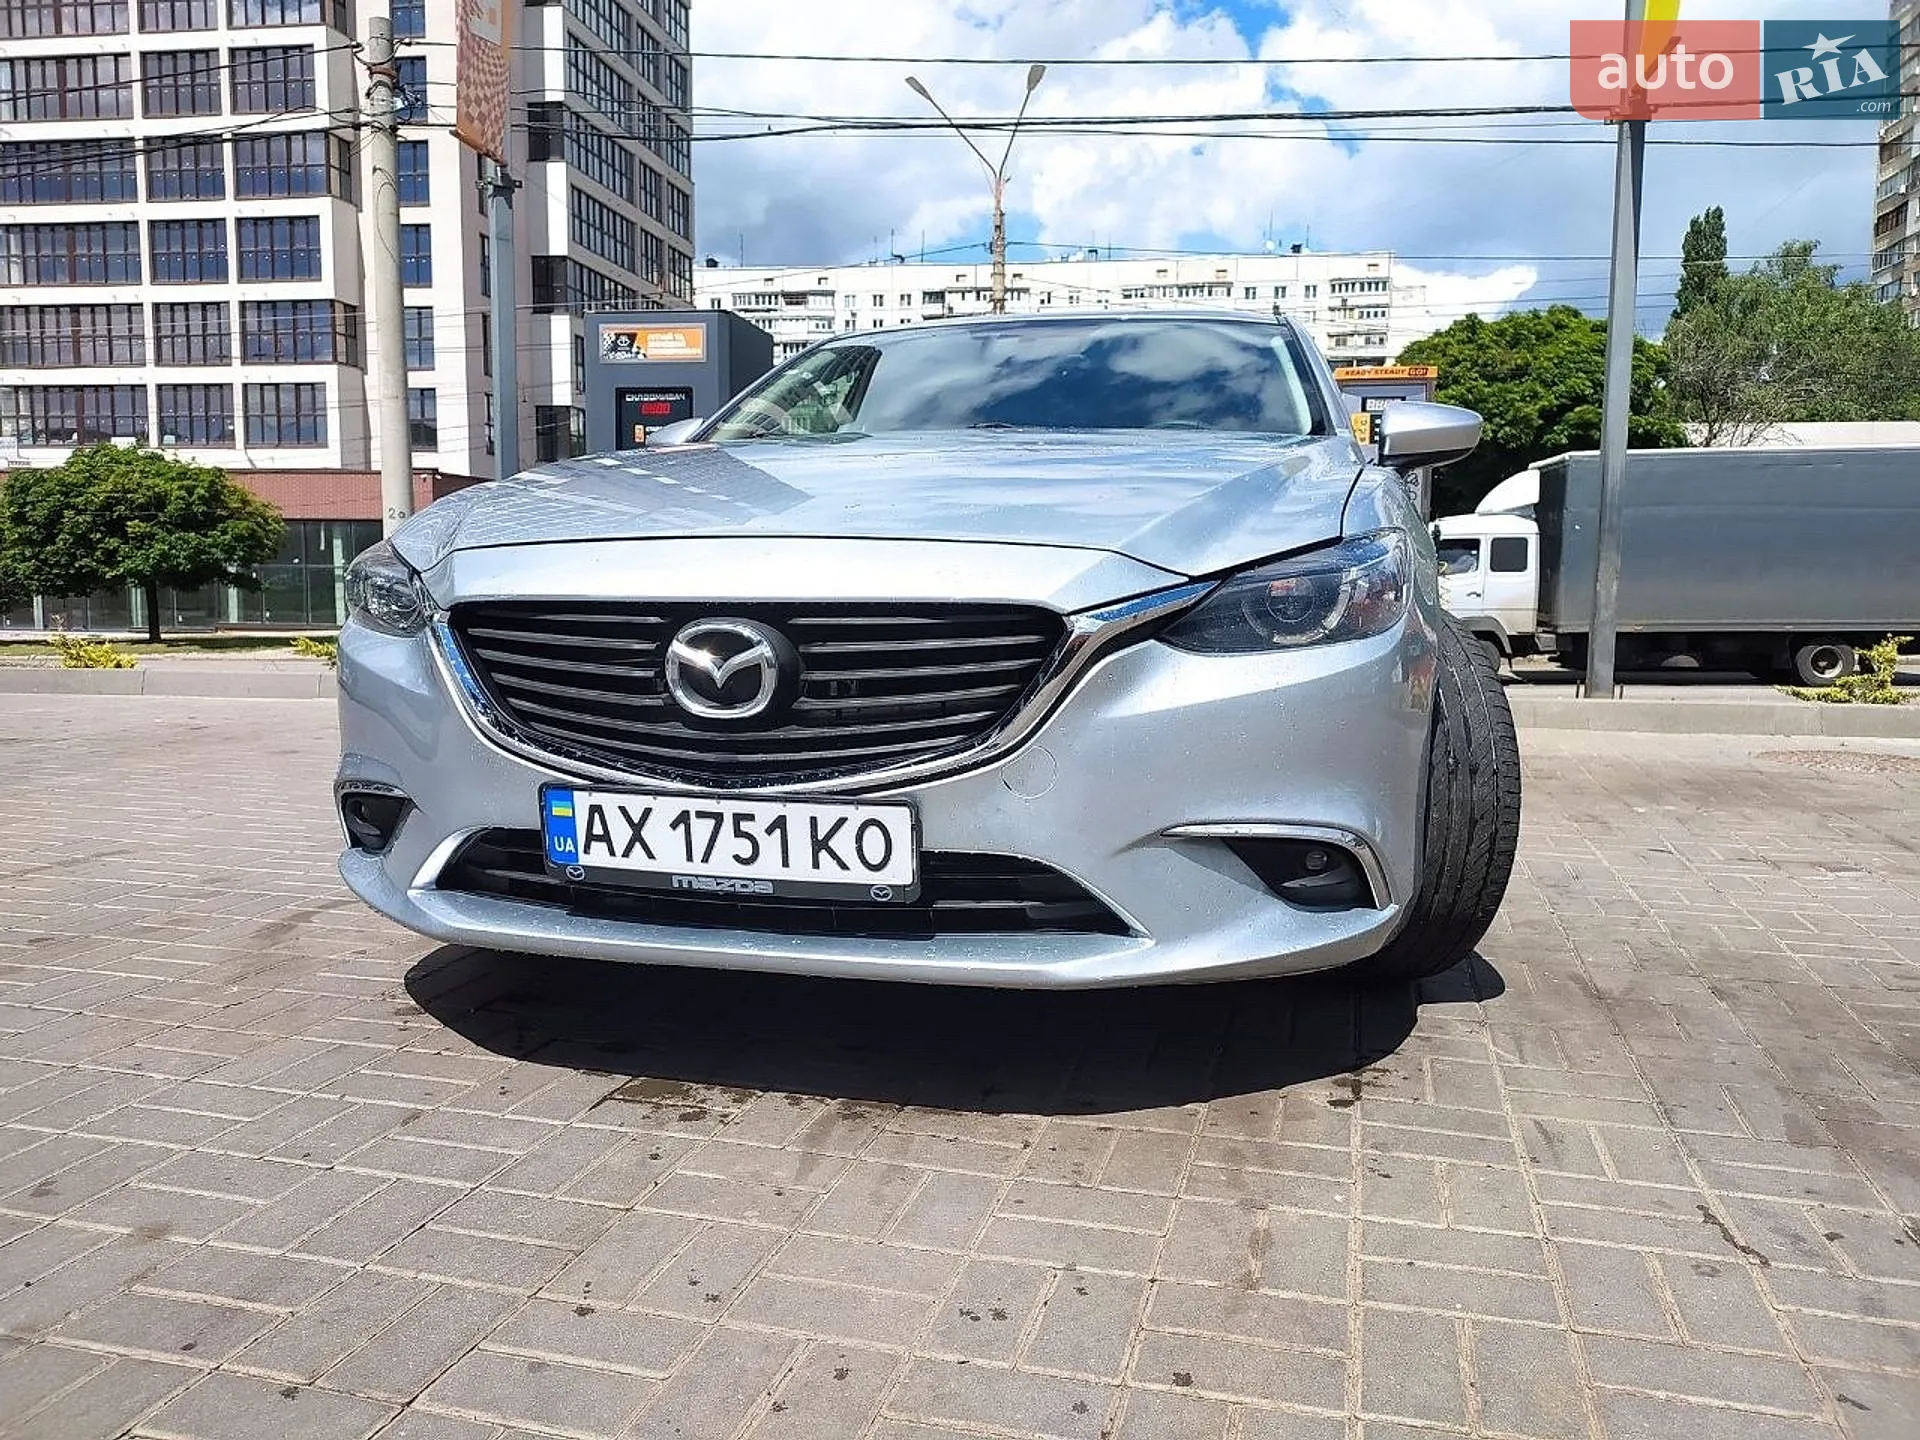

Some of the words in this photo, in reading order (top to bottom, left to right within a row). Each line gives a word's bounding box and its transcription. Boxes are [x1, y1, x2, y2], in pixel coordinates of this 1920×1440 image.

[1374, 368, 1407, 376] STEADY
[554, 835, 576, 854] UA
[583, 804, 657, 861] AX
[668, 808, 791, 869] 1751
[808, 815, 893, 873] KO
[671, 874, 776, 895] mazda
